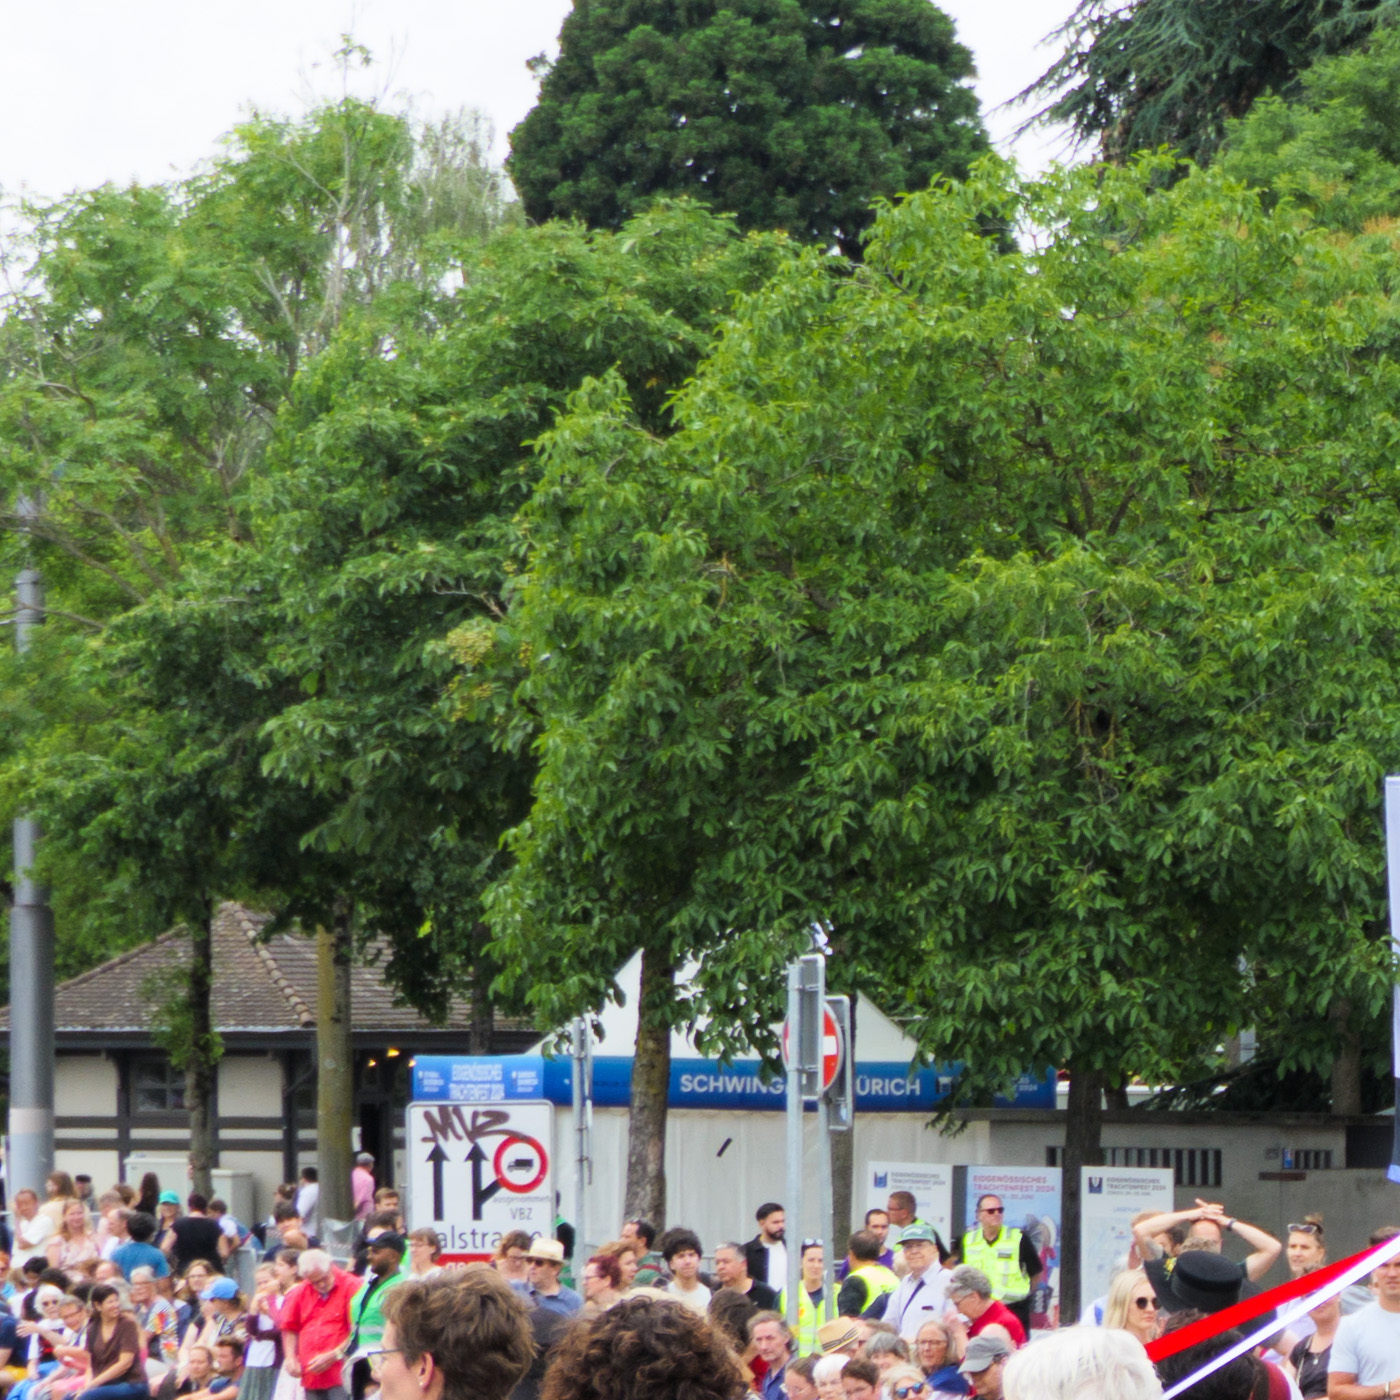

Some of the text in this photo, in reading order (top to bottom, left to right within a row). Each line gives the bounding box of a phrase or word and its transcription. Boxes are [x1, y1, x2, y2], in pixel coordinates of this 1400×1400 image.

[680, 1074, 920, 1096] SCHWING ÜRICH
[510, 1207, 533, 1220] VBZ
